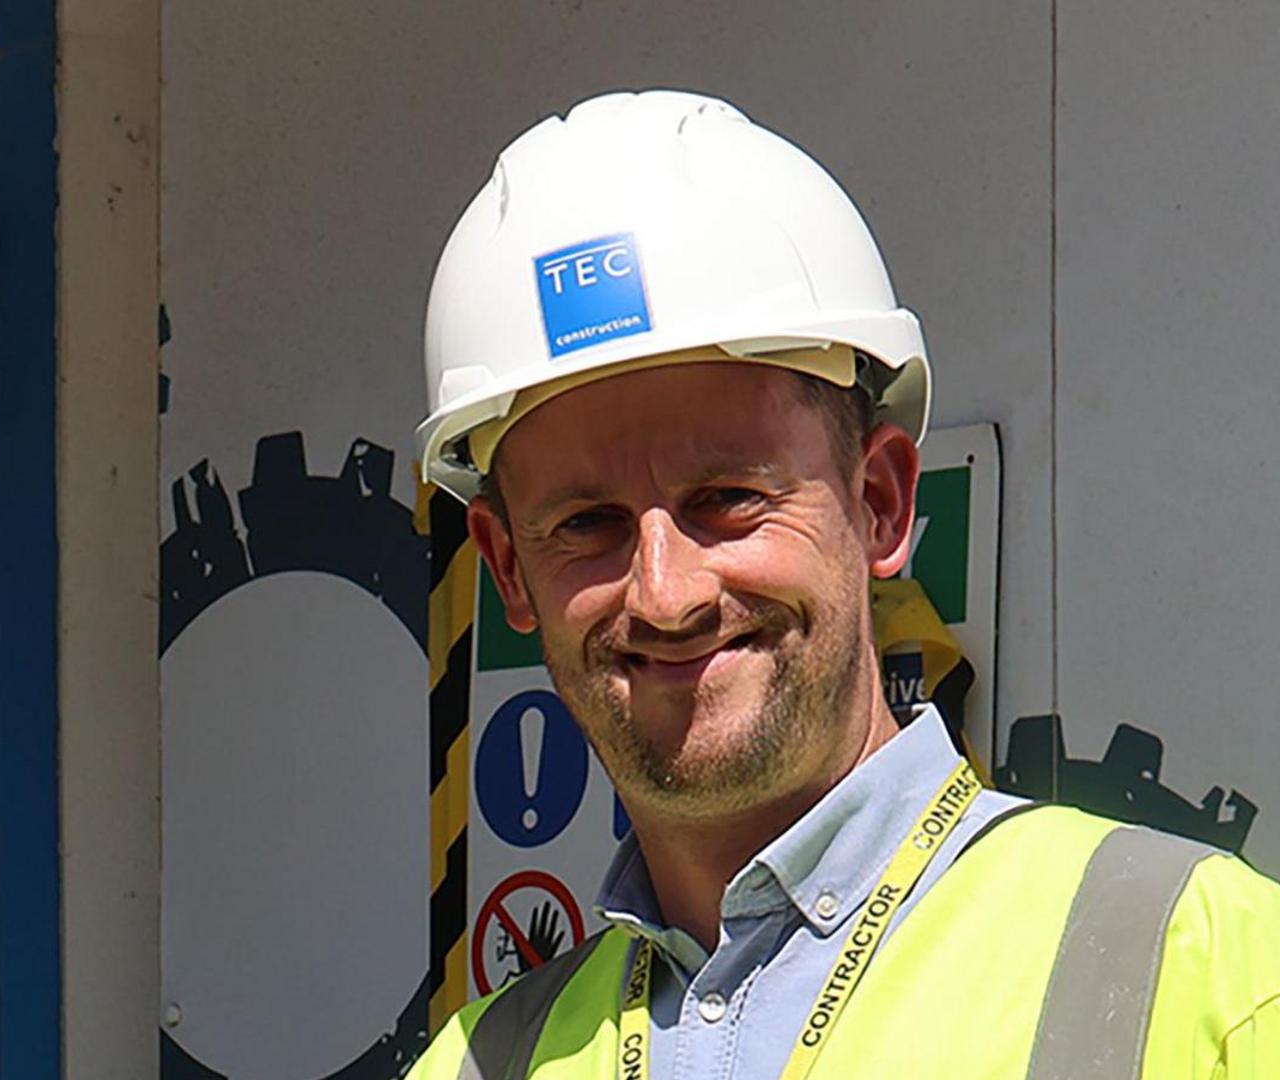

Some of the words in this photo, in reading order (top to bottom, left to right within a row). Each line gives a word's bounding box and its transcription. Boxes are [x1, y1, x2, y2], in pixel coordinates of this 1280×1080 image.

[544, 247, 633, 294] TEC
[556, 315, 641, 347] construction
[801, 882, 901, 1048] CONTRACTOR
